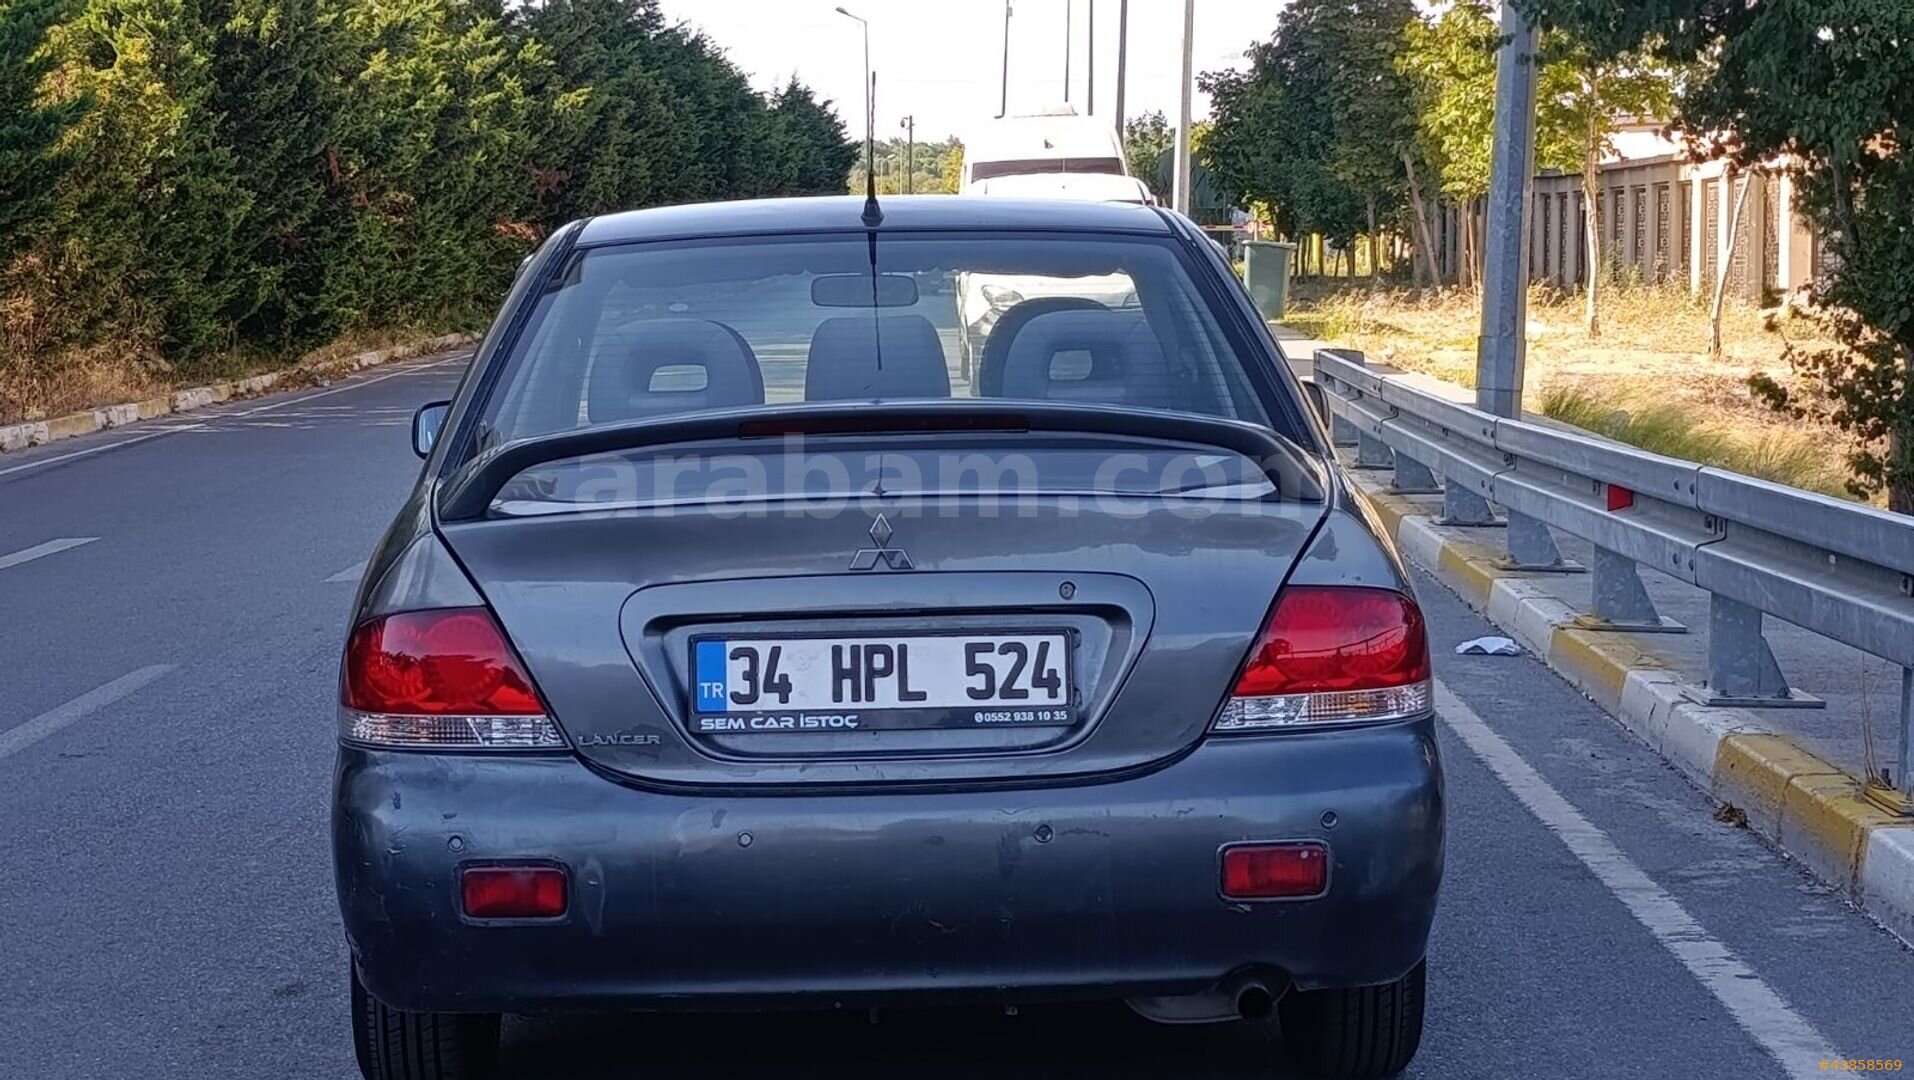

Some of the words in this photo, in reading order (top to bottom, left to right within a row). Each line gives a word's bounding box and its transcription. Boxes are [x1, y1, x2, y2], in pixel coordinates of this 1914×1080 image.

[729, 645, 793, 705] 34
[831, 643, 926, 703] HPL
[965, 641, 1061, 700] 524
[700, 682, 724, 698] TR
[700, 718, 745, 730] SEM
[750, 717, 795, 729] CAR
[800, 713, 858, 728] İSTOÇ
[984, 712, 1012, 722] 0552
[1038, 711, 1051, 721] 10
[1053, 710, 1067, 720] 35
[578, 733, 660, 745] LANCER
